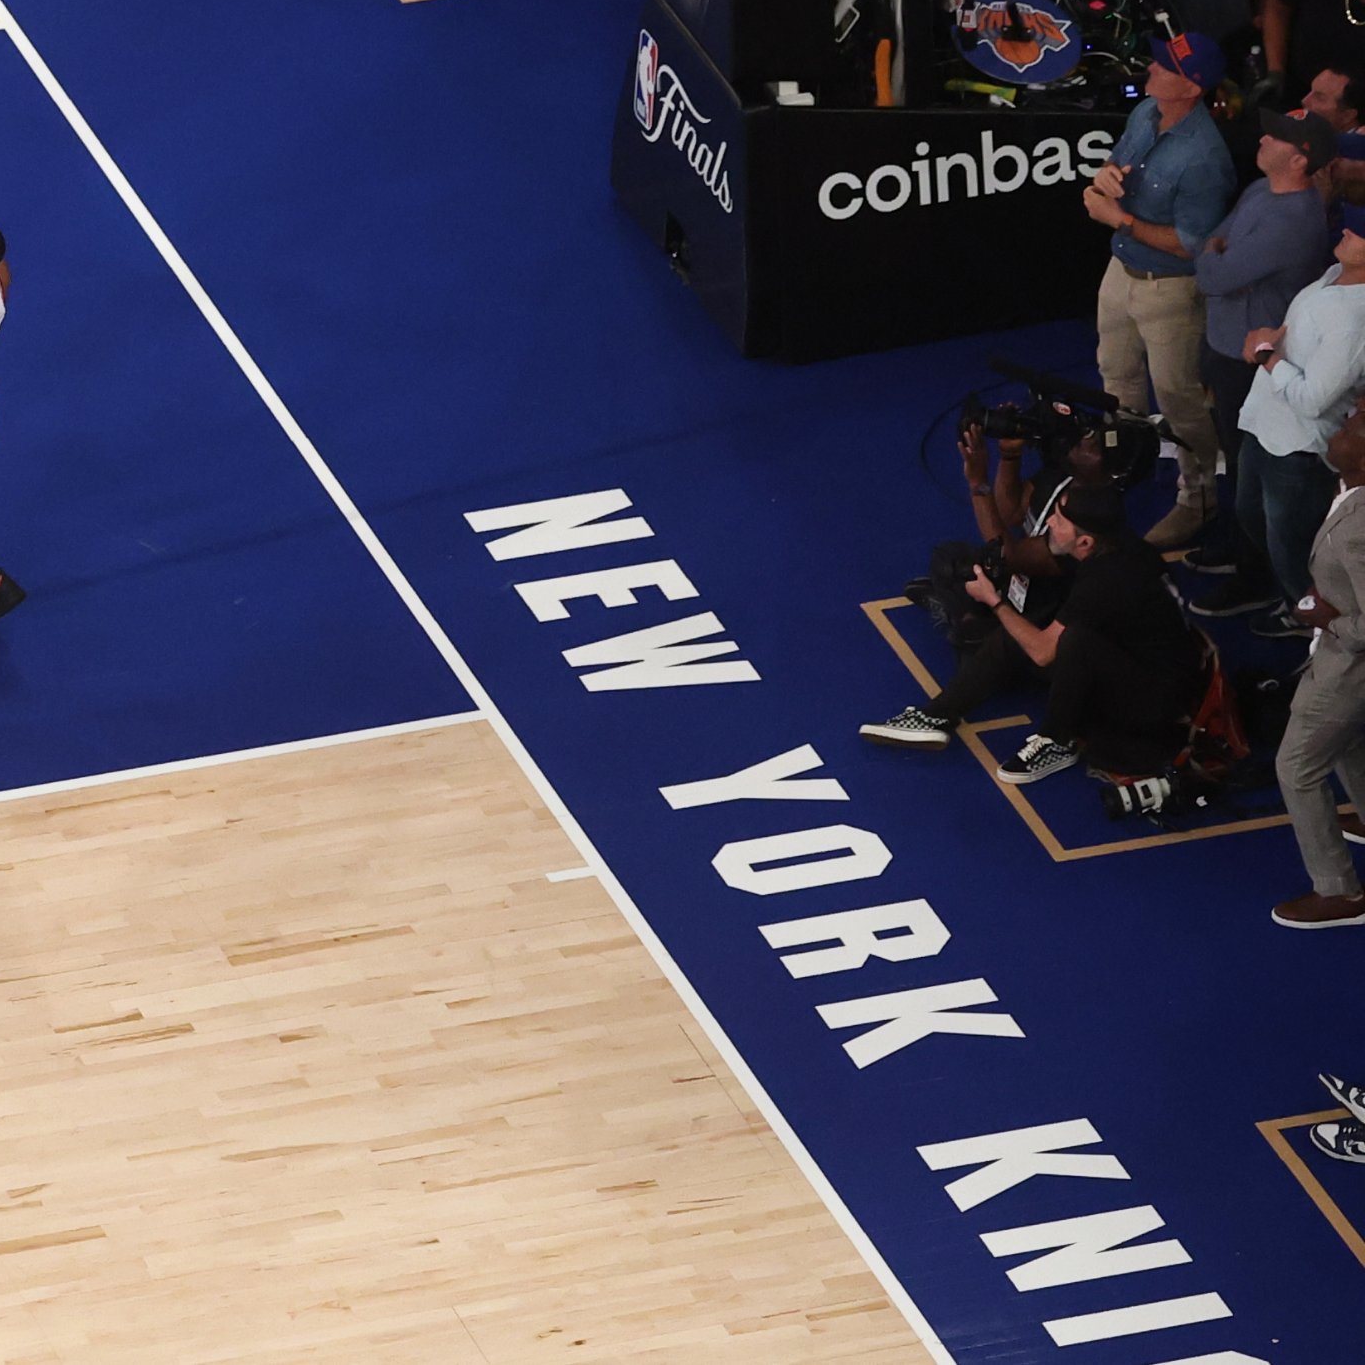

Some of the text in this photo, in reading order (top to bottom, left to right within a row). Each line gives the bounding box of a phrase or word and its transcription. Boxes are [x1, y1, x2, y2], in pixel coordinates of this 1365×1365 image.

[641, 64, 733, 214] Finals
[817, 129, 1116, 221] coinbas
[462, 488, 1271, 1365] NEW YORK KNI
